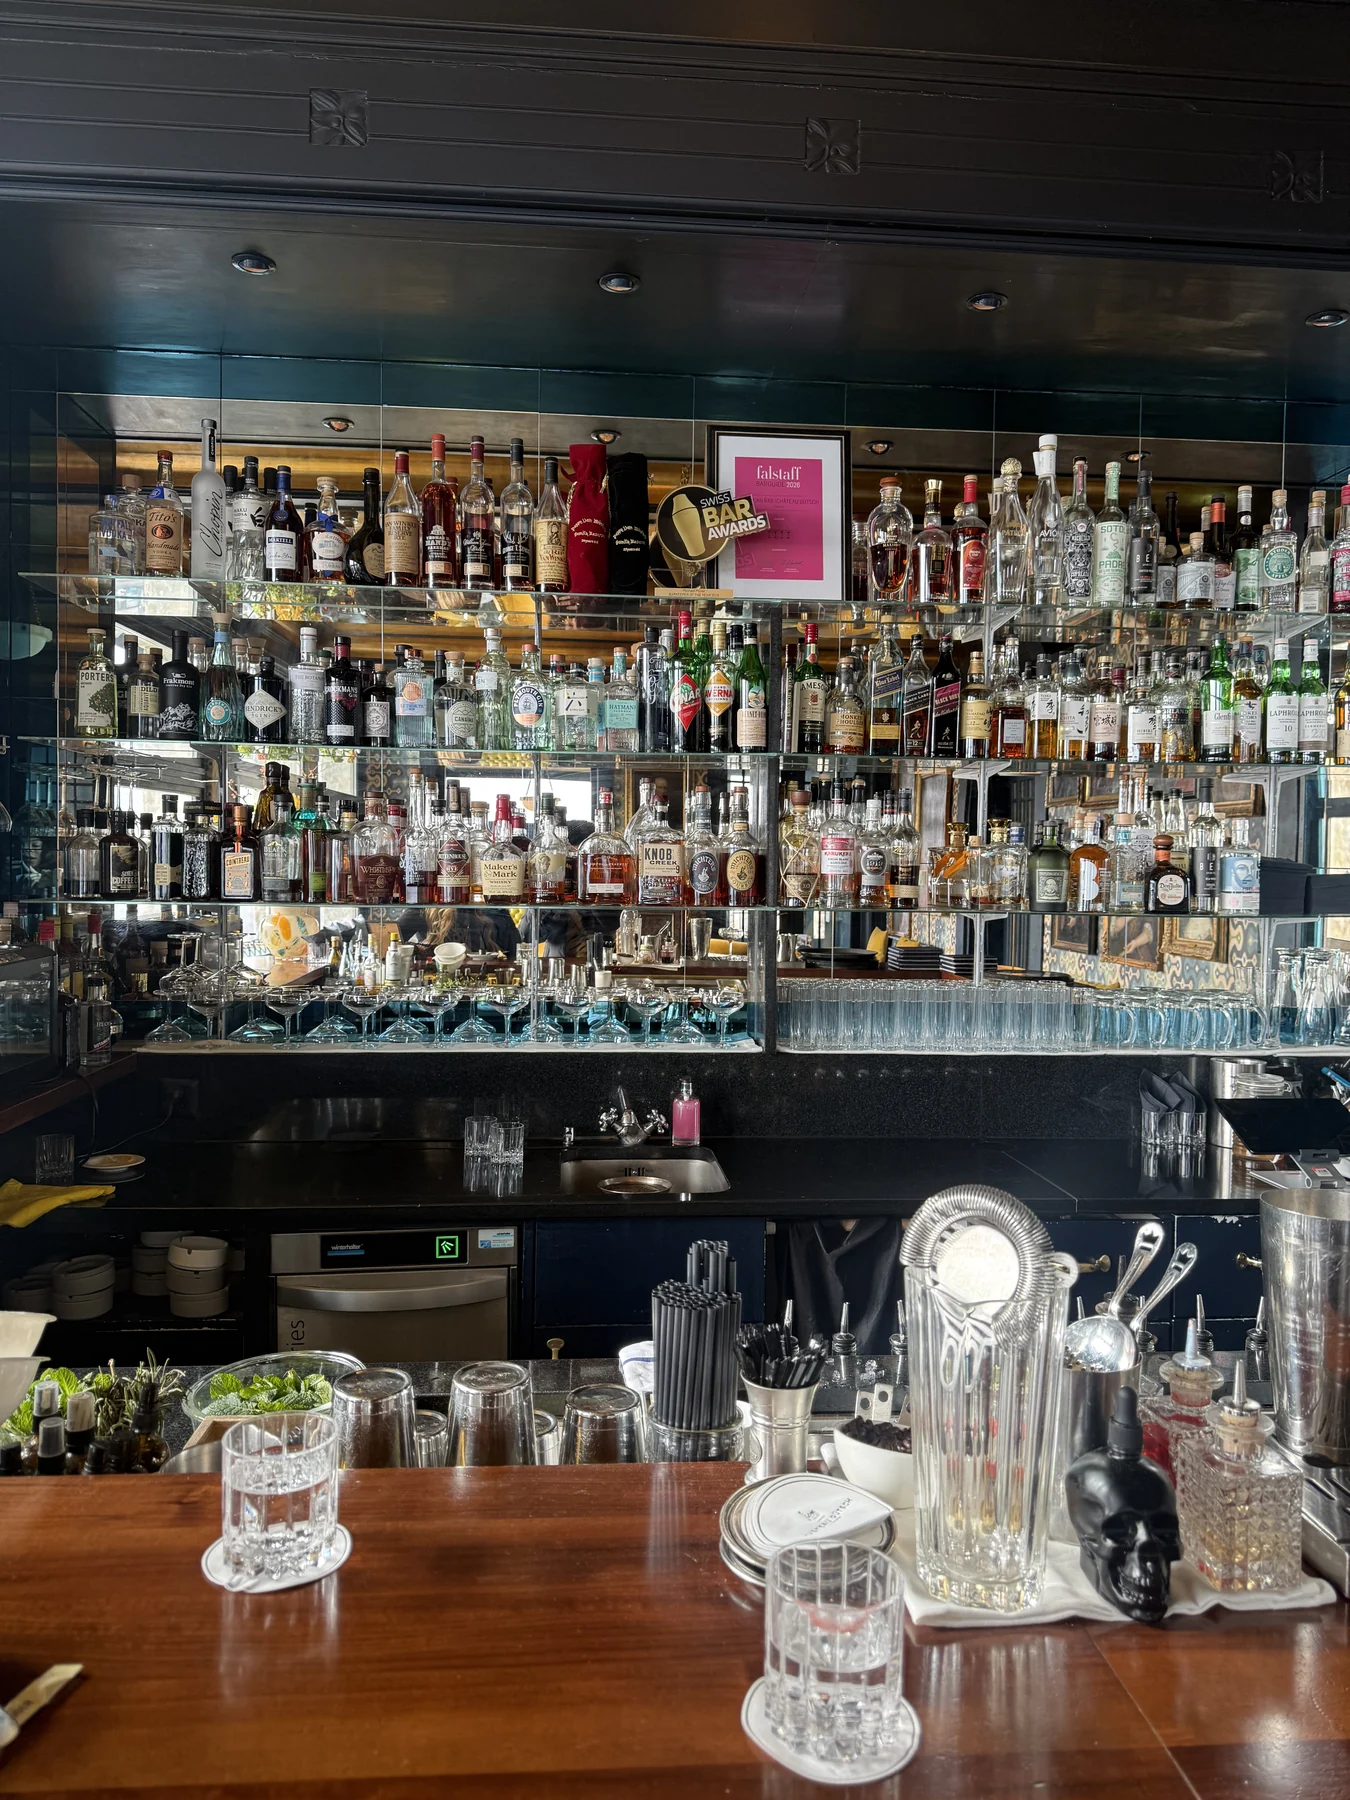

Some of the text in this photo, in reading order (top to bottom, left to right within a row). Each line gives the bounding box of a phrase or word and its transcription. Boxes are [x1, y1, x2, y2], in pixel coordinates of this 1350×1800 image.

[757, 465, 802, 480] falstaff
[700, 493, 730, 508] SWISS
[149, 511, 178, 524] Tito's
[702, 499, 754, 528] BAR
[200, 488, 223, 557] Chopin
[708, 515, 767, 541] AWARDS
[147, 541, 180, 552] Handmade
[81, 672, 114, 682] PORTERS
[800, 681, 825, 691] AMESO
[513, 686, 538, 707] PLYMOUTH
[705, 689, 732, 698] AVERNA
[645, 848, 672, 860] KNOB
[226, 856, 250, 867] COINTREAU
[675, 865, 680, 874] 9
[112, 876, 135, 884] COFFEE
